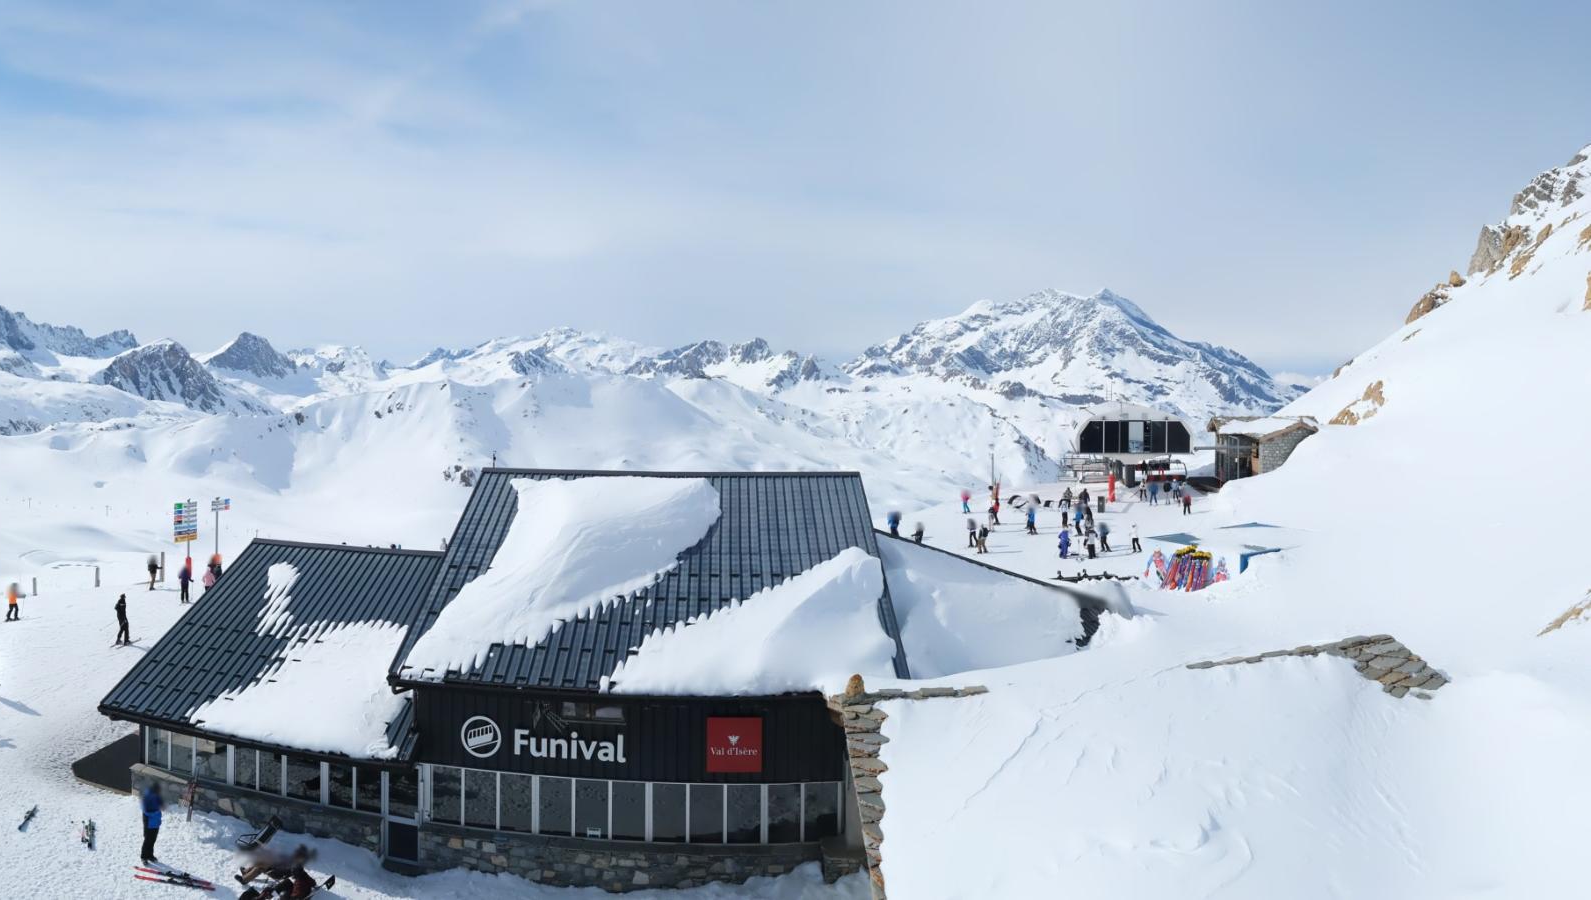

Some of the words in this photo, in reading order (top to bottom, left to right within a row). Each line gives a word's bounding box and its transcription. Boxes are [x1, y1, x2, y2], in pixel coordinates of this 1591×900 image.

[513, 728, 627, 764] Funival
[710, 746, 725, 756] Val
[727, 746, 758, 756] d'Isère
